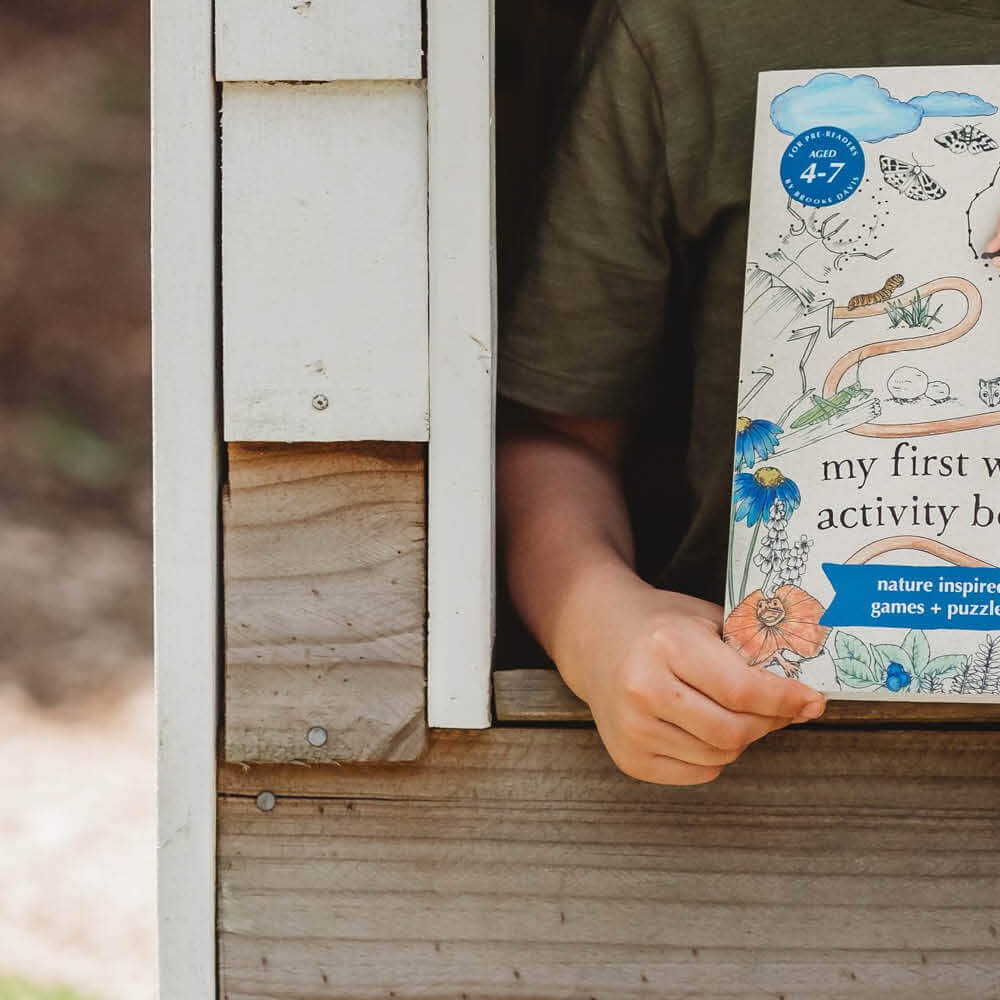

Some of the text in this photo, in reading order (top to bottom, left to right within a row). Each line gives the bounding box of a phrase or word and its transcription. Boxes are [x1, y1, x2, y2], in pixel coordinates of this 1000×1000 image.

[788, 141, 804, 158] FOR
[808, 149, 837, 158] AGED
[800, 162, 846, 184] 4-7
[785, 176, 860, 205] BY BROOKE DAVIS
[822, 457, 878, 489] my
[891, 441, 970, 477] first
[817, 496, 958, 537] activity
[877, 578, 933, 593] nature
[871, 601, 925, 618] games
[930, 603, 942, 615] +
